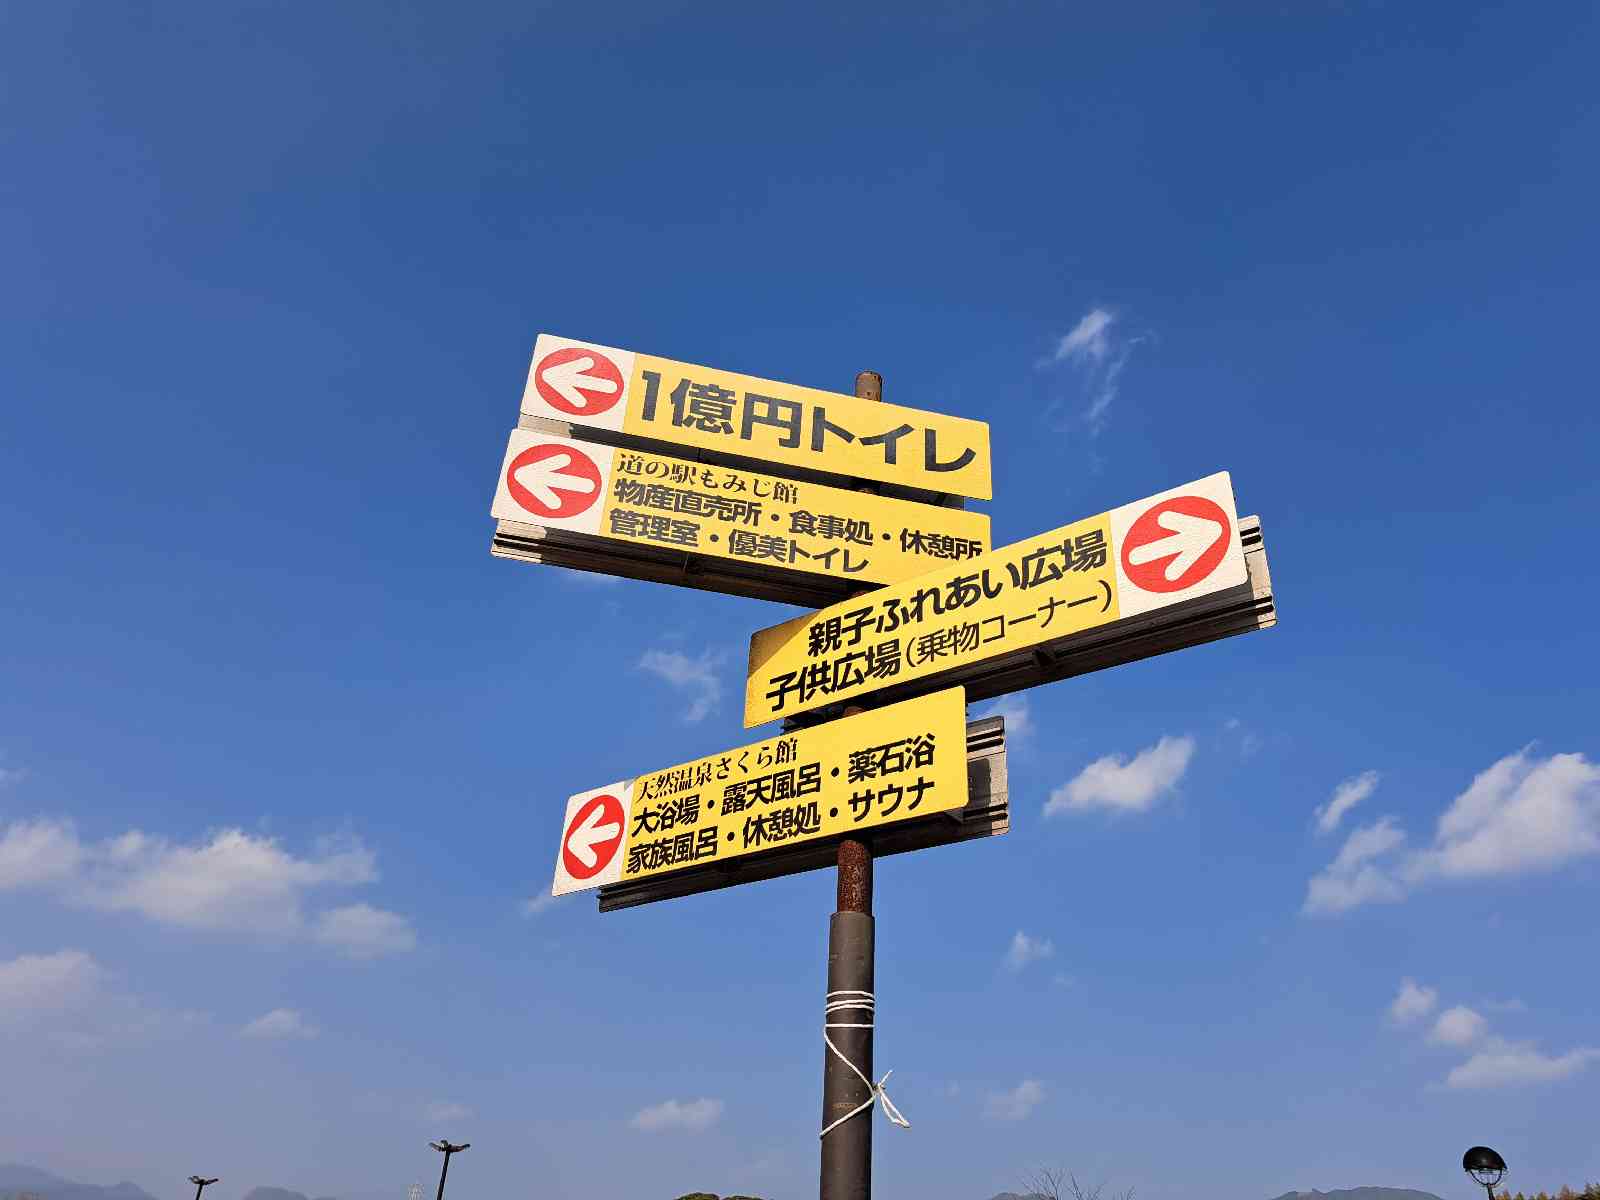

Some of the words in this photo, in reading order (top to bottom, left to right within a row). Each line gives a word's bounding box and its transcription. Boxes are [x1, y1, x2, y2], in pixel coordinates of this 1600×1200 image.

[641, 370, 976, 472] 1億円トイレ
[614, 478, 983, 560] 物産直売所・食事処・休憩所
[617, 453, 799, 504] 道の駅もみじ館
[610, 508, 869, 573] 管理室・優美トイレ
[808, 528, 1108, 658] 親子ふれあい広場
[631, 733, 936, 837] 大浴場・露天風呂・薬石浴
[635, 737, 798, 804] 天然温泉さくら館
[626, 776, 936, 874] 家族風呂・休憩処・サウナ
